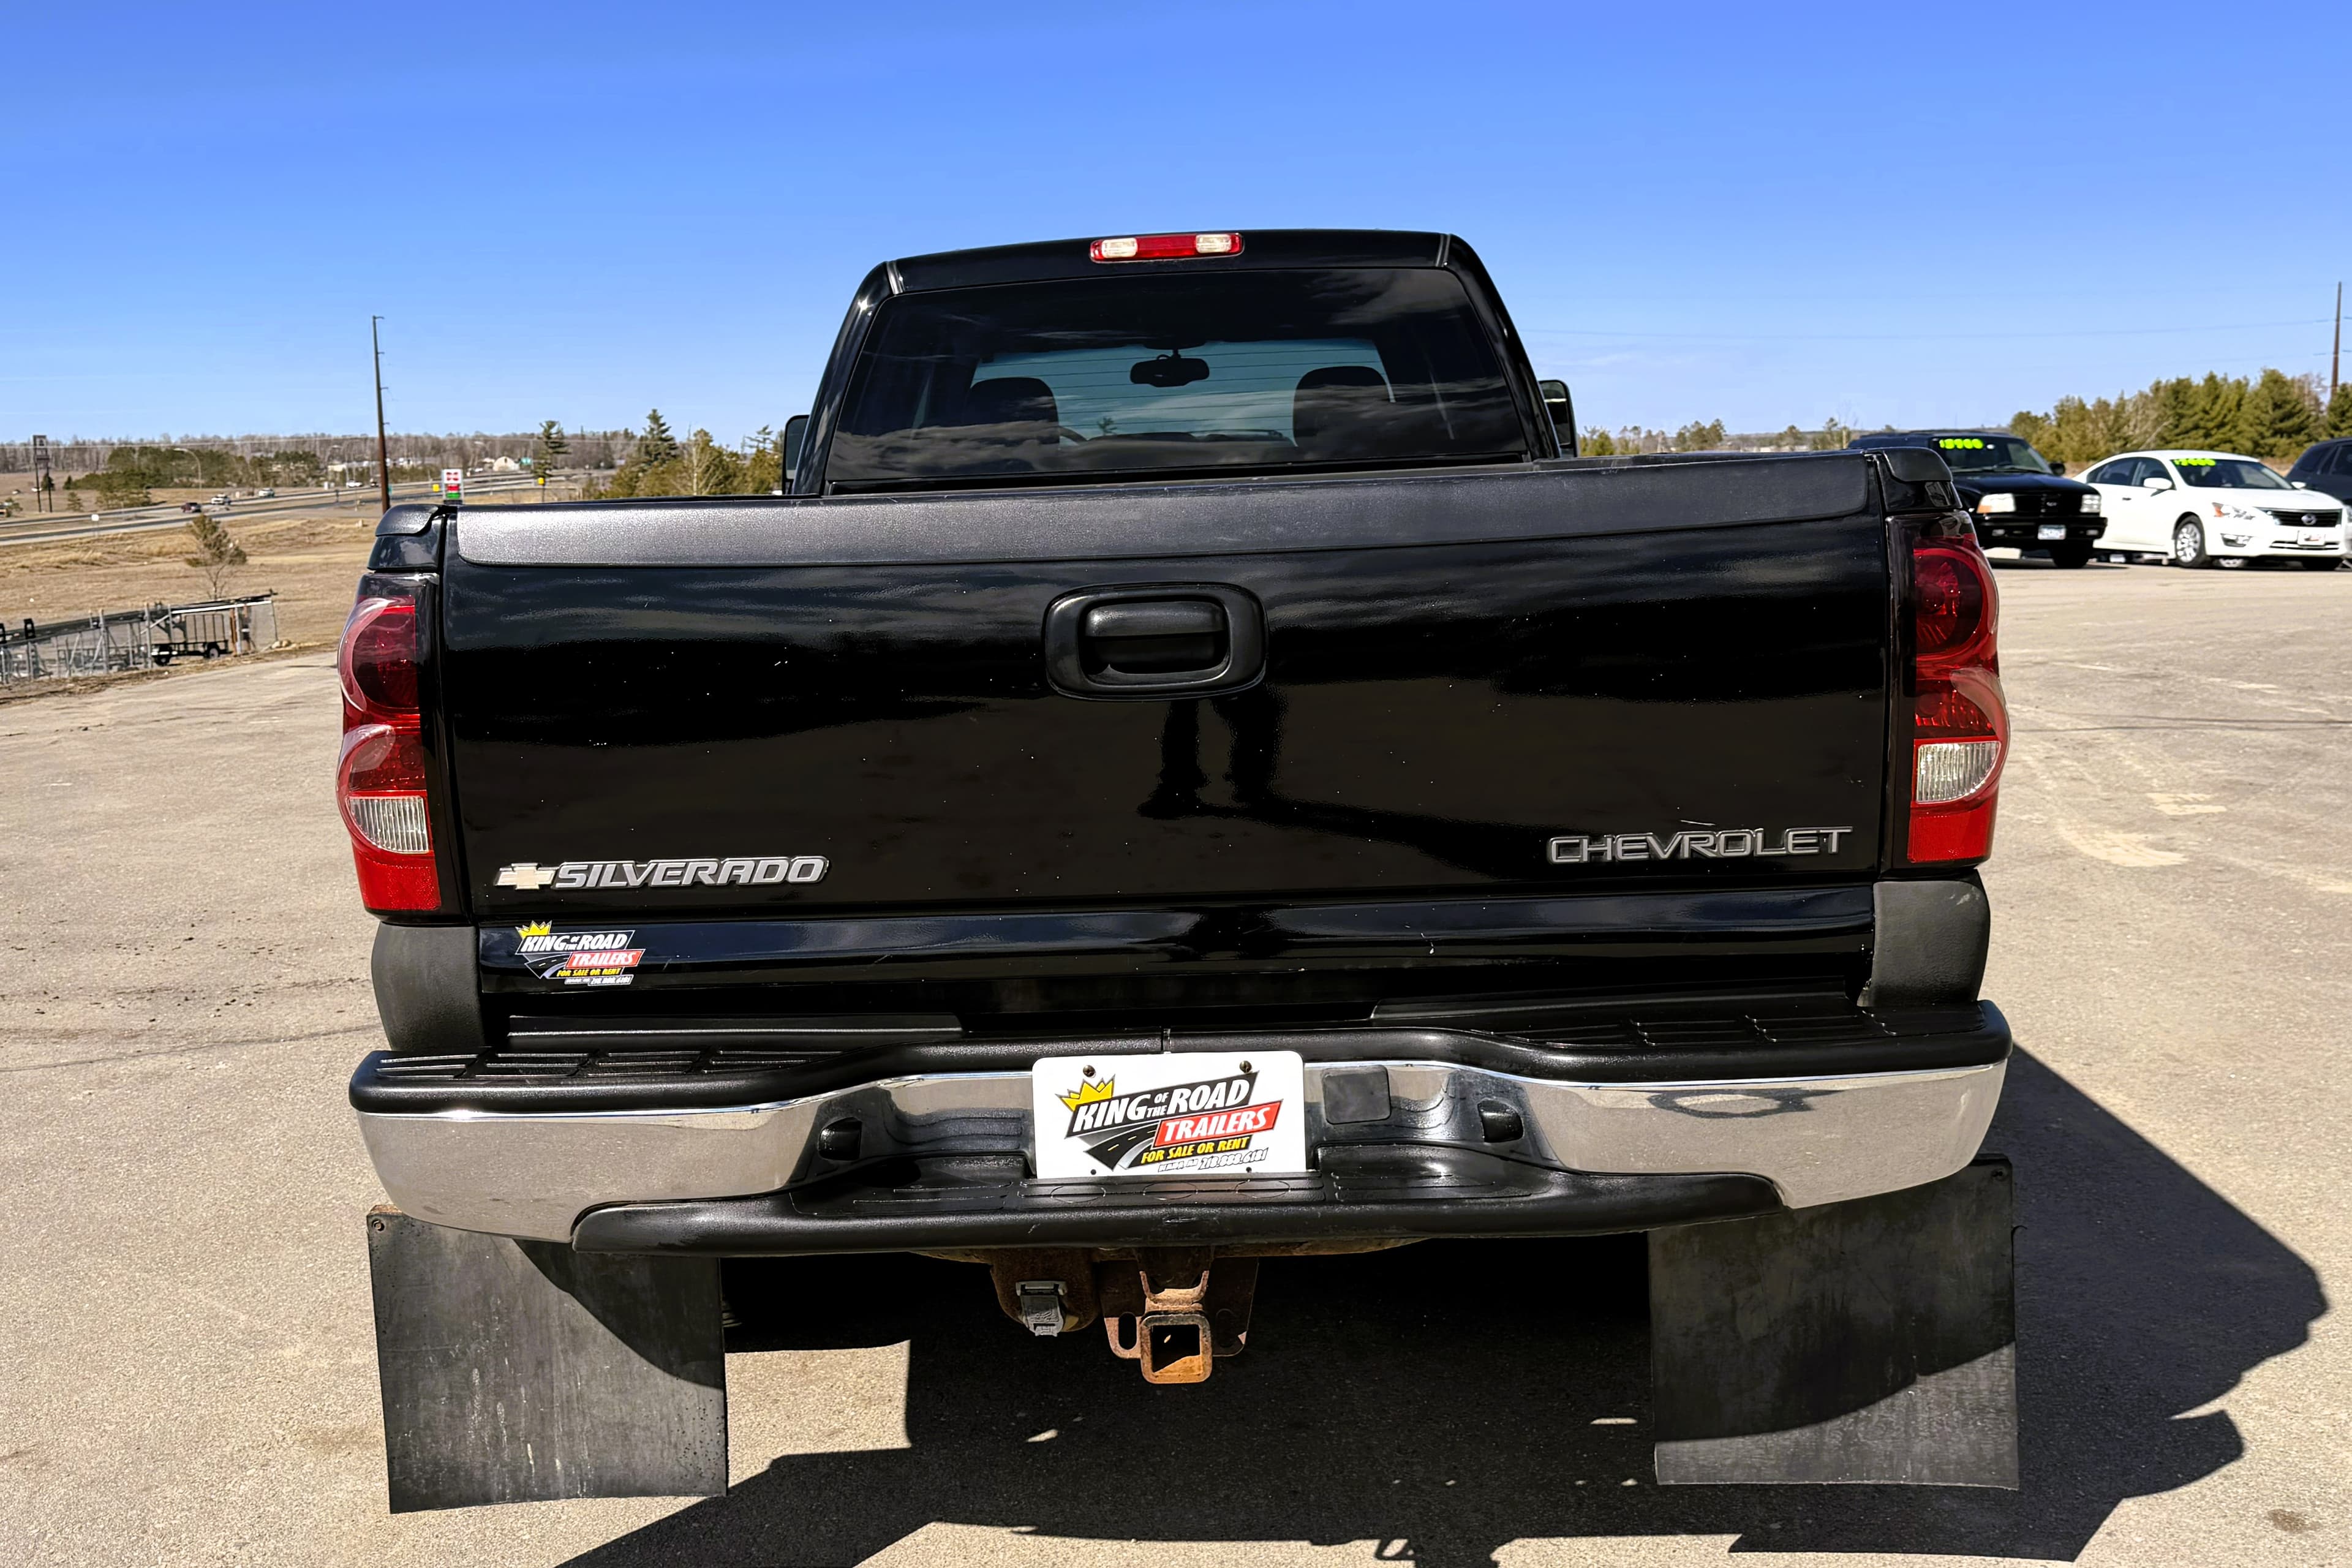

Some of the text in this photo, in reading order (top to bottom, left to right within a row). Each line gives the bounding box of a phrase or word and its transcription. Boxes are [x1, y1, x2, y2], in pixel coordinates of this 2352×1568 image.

[1548, 826, 1853, 864] CHEVROLET
[554, 857, 827, 889] SILVERADO
[521, 935, 570, 952] KING
[577, 933, 628, 950] ROAD
[571, 952, 637, 967] TRAILERS
[1072, 1079, 1251, 1133] KING OF THE ROAD
[1164, 1106, 1271, 1142] TRAILERS
[1140, 1137, 1250, 1164] FOR SALE OR RENT
